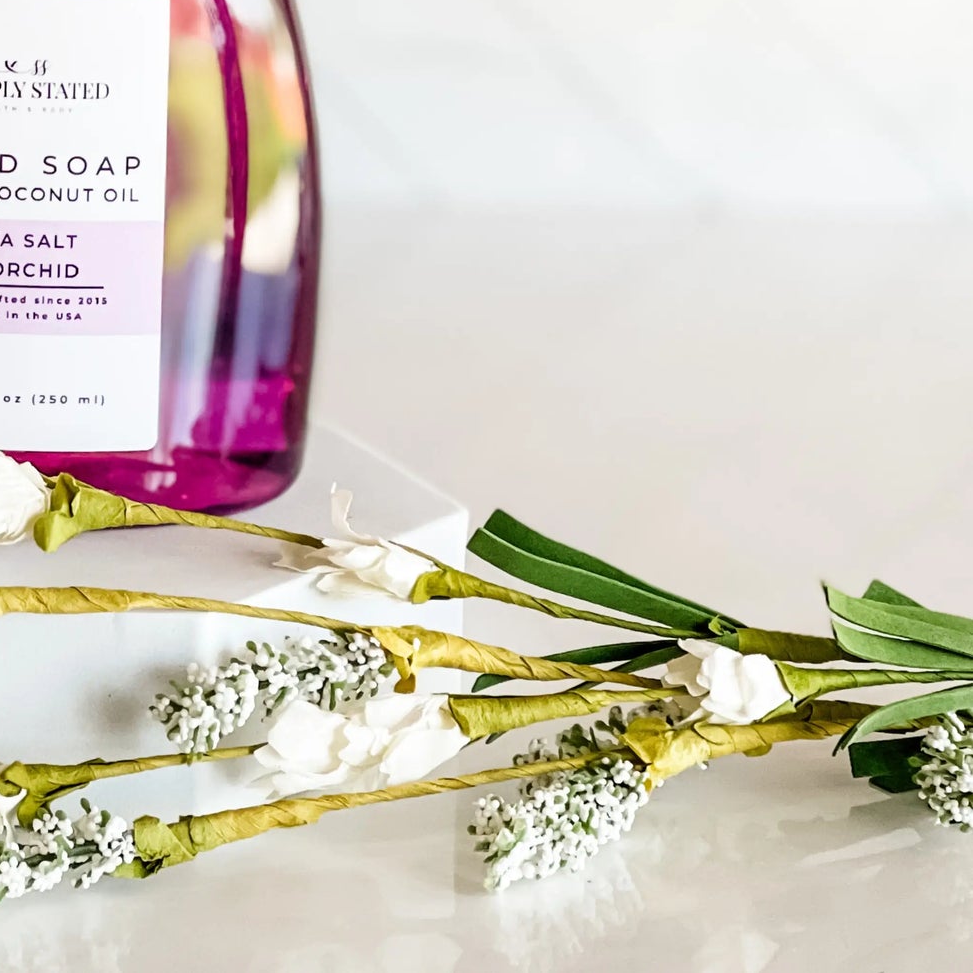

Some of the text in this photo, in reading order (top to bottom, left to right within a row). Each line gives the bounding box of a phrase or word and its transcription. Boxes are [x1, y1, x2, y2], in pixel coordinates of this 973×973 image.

[31, 82, 110, 100] STATED
[43, 155, 141, 176] SOAP
[104, 188, 139, 202] OIL
[24, 234, 78, 249] SALT
[34, 296, 71, 306] since
[78, 297, 108, 306] 2015
[6, 311, 19, 320] in
[26, 312, 49, 321] the
[56, 312, 83, 321] USA
[3, 395, 22, 404] oz
[32, 394, 68, 406] (250
[78, 395, 105, 406] ml)
